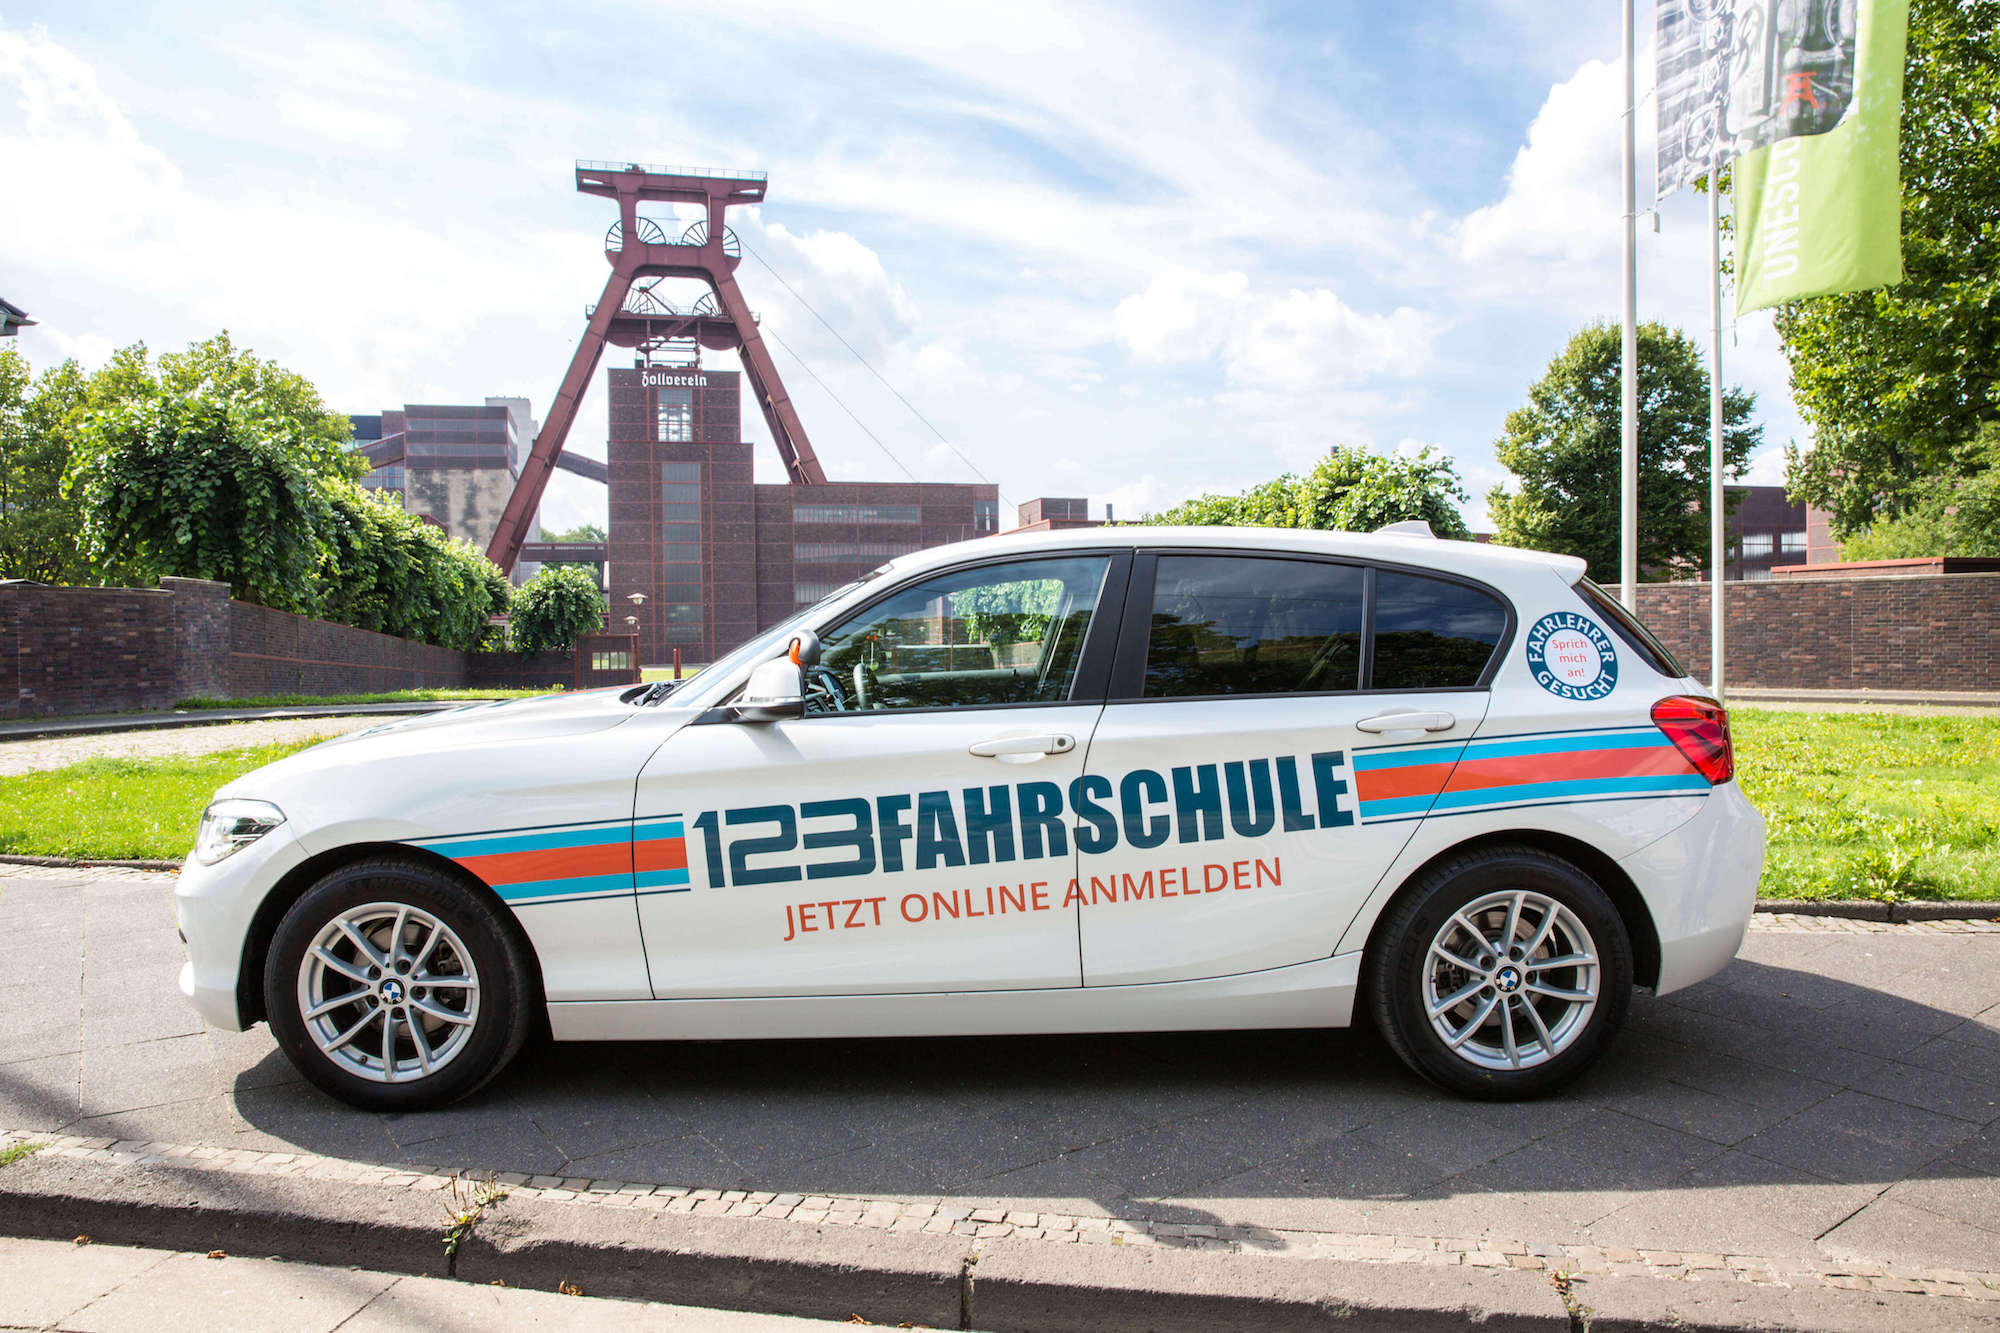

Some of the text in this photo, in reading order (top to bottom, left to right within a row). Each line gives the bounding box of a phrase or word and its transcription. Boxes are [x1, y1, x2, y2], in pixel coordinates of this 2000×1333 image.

[1529, 614, 1615, 662] FAHRLEHRER
[1552, 640, 1588, 650] Sprich
[1559, 653, 1587, 663] mich
[1567, 668, 1585, 677] an!
[1537, 670, 1615, 699] GESUCHT
[783, 856, 1283, 942] JETZT ONLINE ANMELDEN
